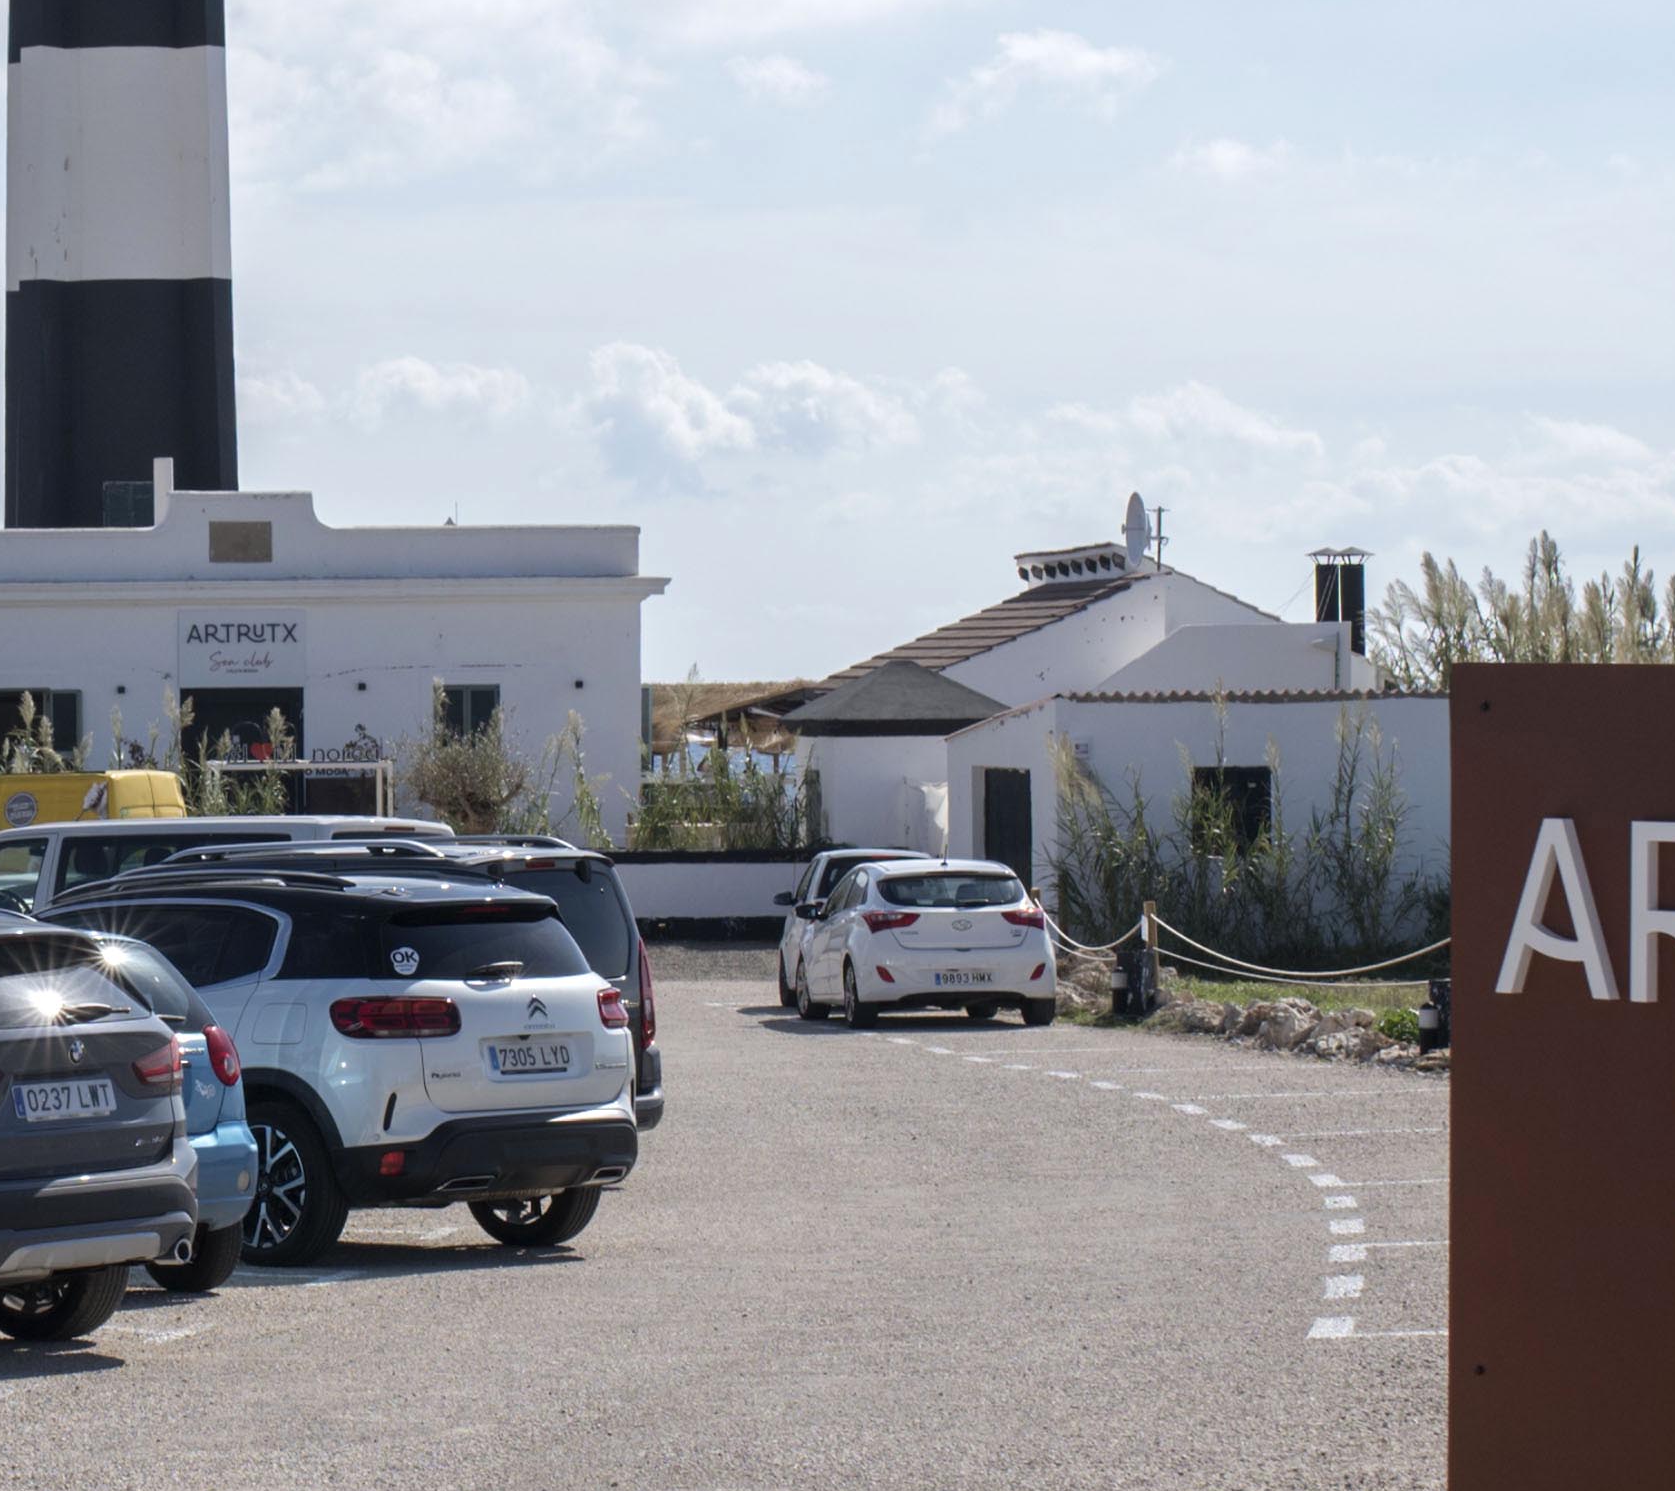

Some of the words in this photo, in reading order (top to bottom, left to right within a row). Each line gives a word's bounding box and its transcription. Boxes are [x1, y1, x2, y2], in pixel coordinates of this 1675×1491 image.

[186, 623, 297, 644] ARTRUTX
[209, 650, 239, 671] Sea
[242, 651, 274, 669] club
[392, 950, 417, 963] OK
[942, 973, 969, 983] 9893
[971, 972, 992, 983] HMX
[498, 1047, 536, 1067] 7305
[542, 1045, 570, 1065] LYD
[26, 1086, 71, 1112] 0237
[79, 1083, 110, 1109] LWT
